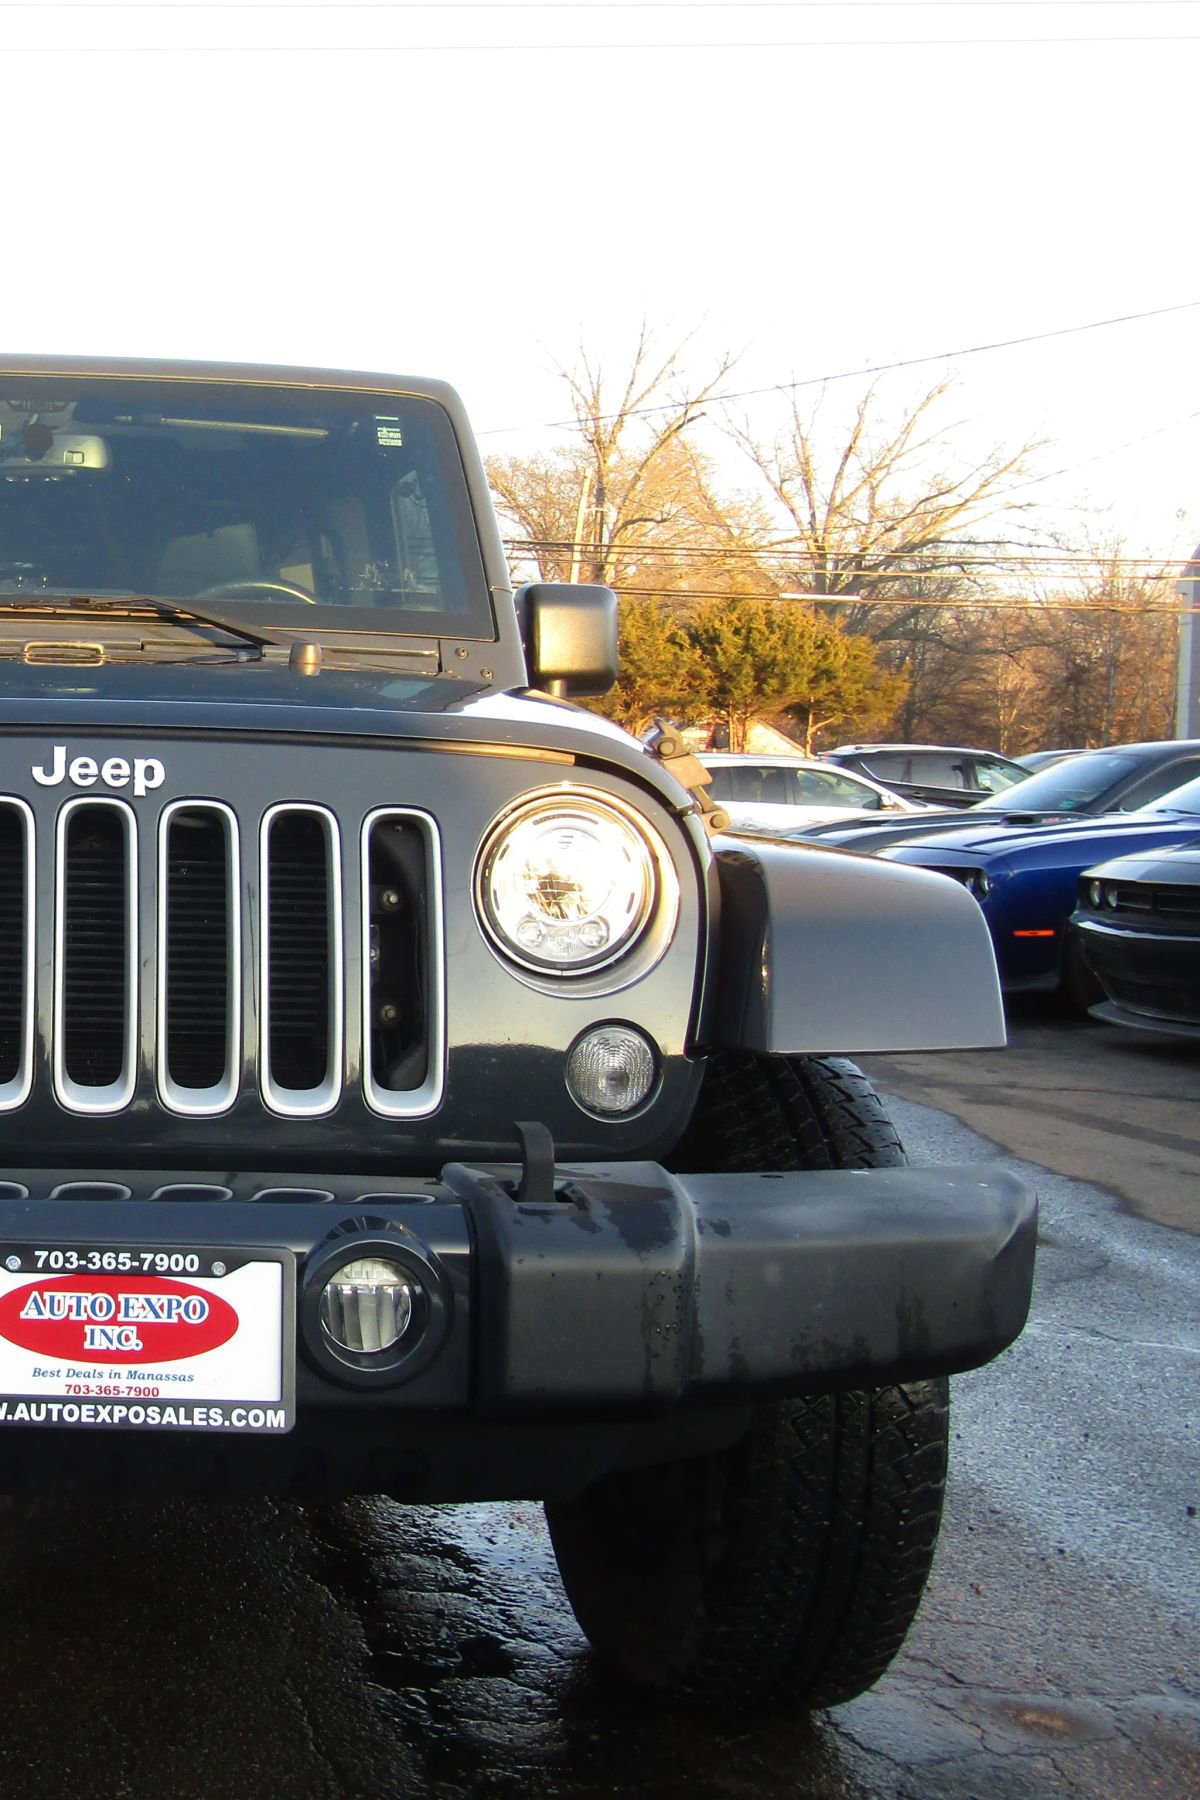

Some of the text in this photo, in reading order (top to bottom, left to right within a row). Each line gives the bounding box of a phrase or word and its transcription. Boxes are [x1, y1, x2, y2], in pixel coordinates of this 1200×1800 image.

[31, 745, 166, 797] Jeep
[33, 1250, 199, 1273] 703-365-7900
[21, 1291, 208, 1325] AUTO EXPO
[84, 1325, 144, 1351] INC.
[31, 1367, 195, 1382] Best Deals in Manassas
[64, 1384, 160, 1398] 703-365-7900
